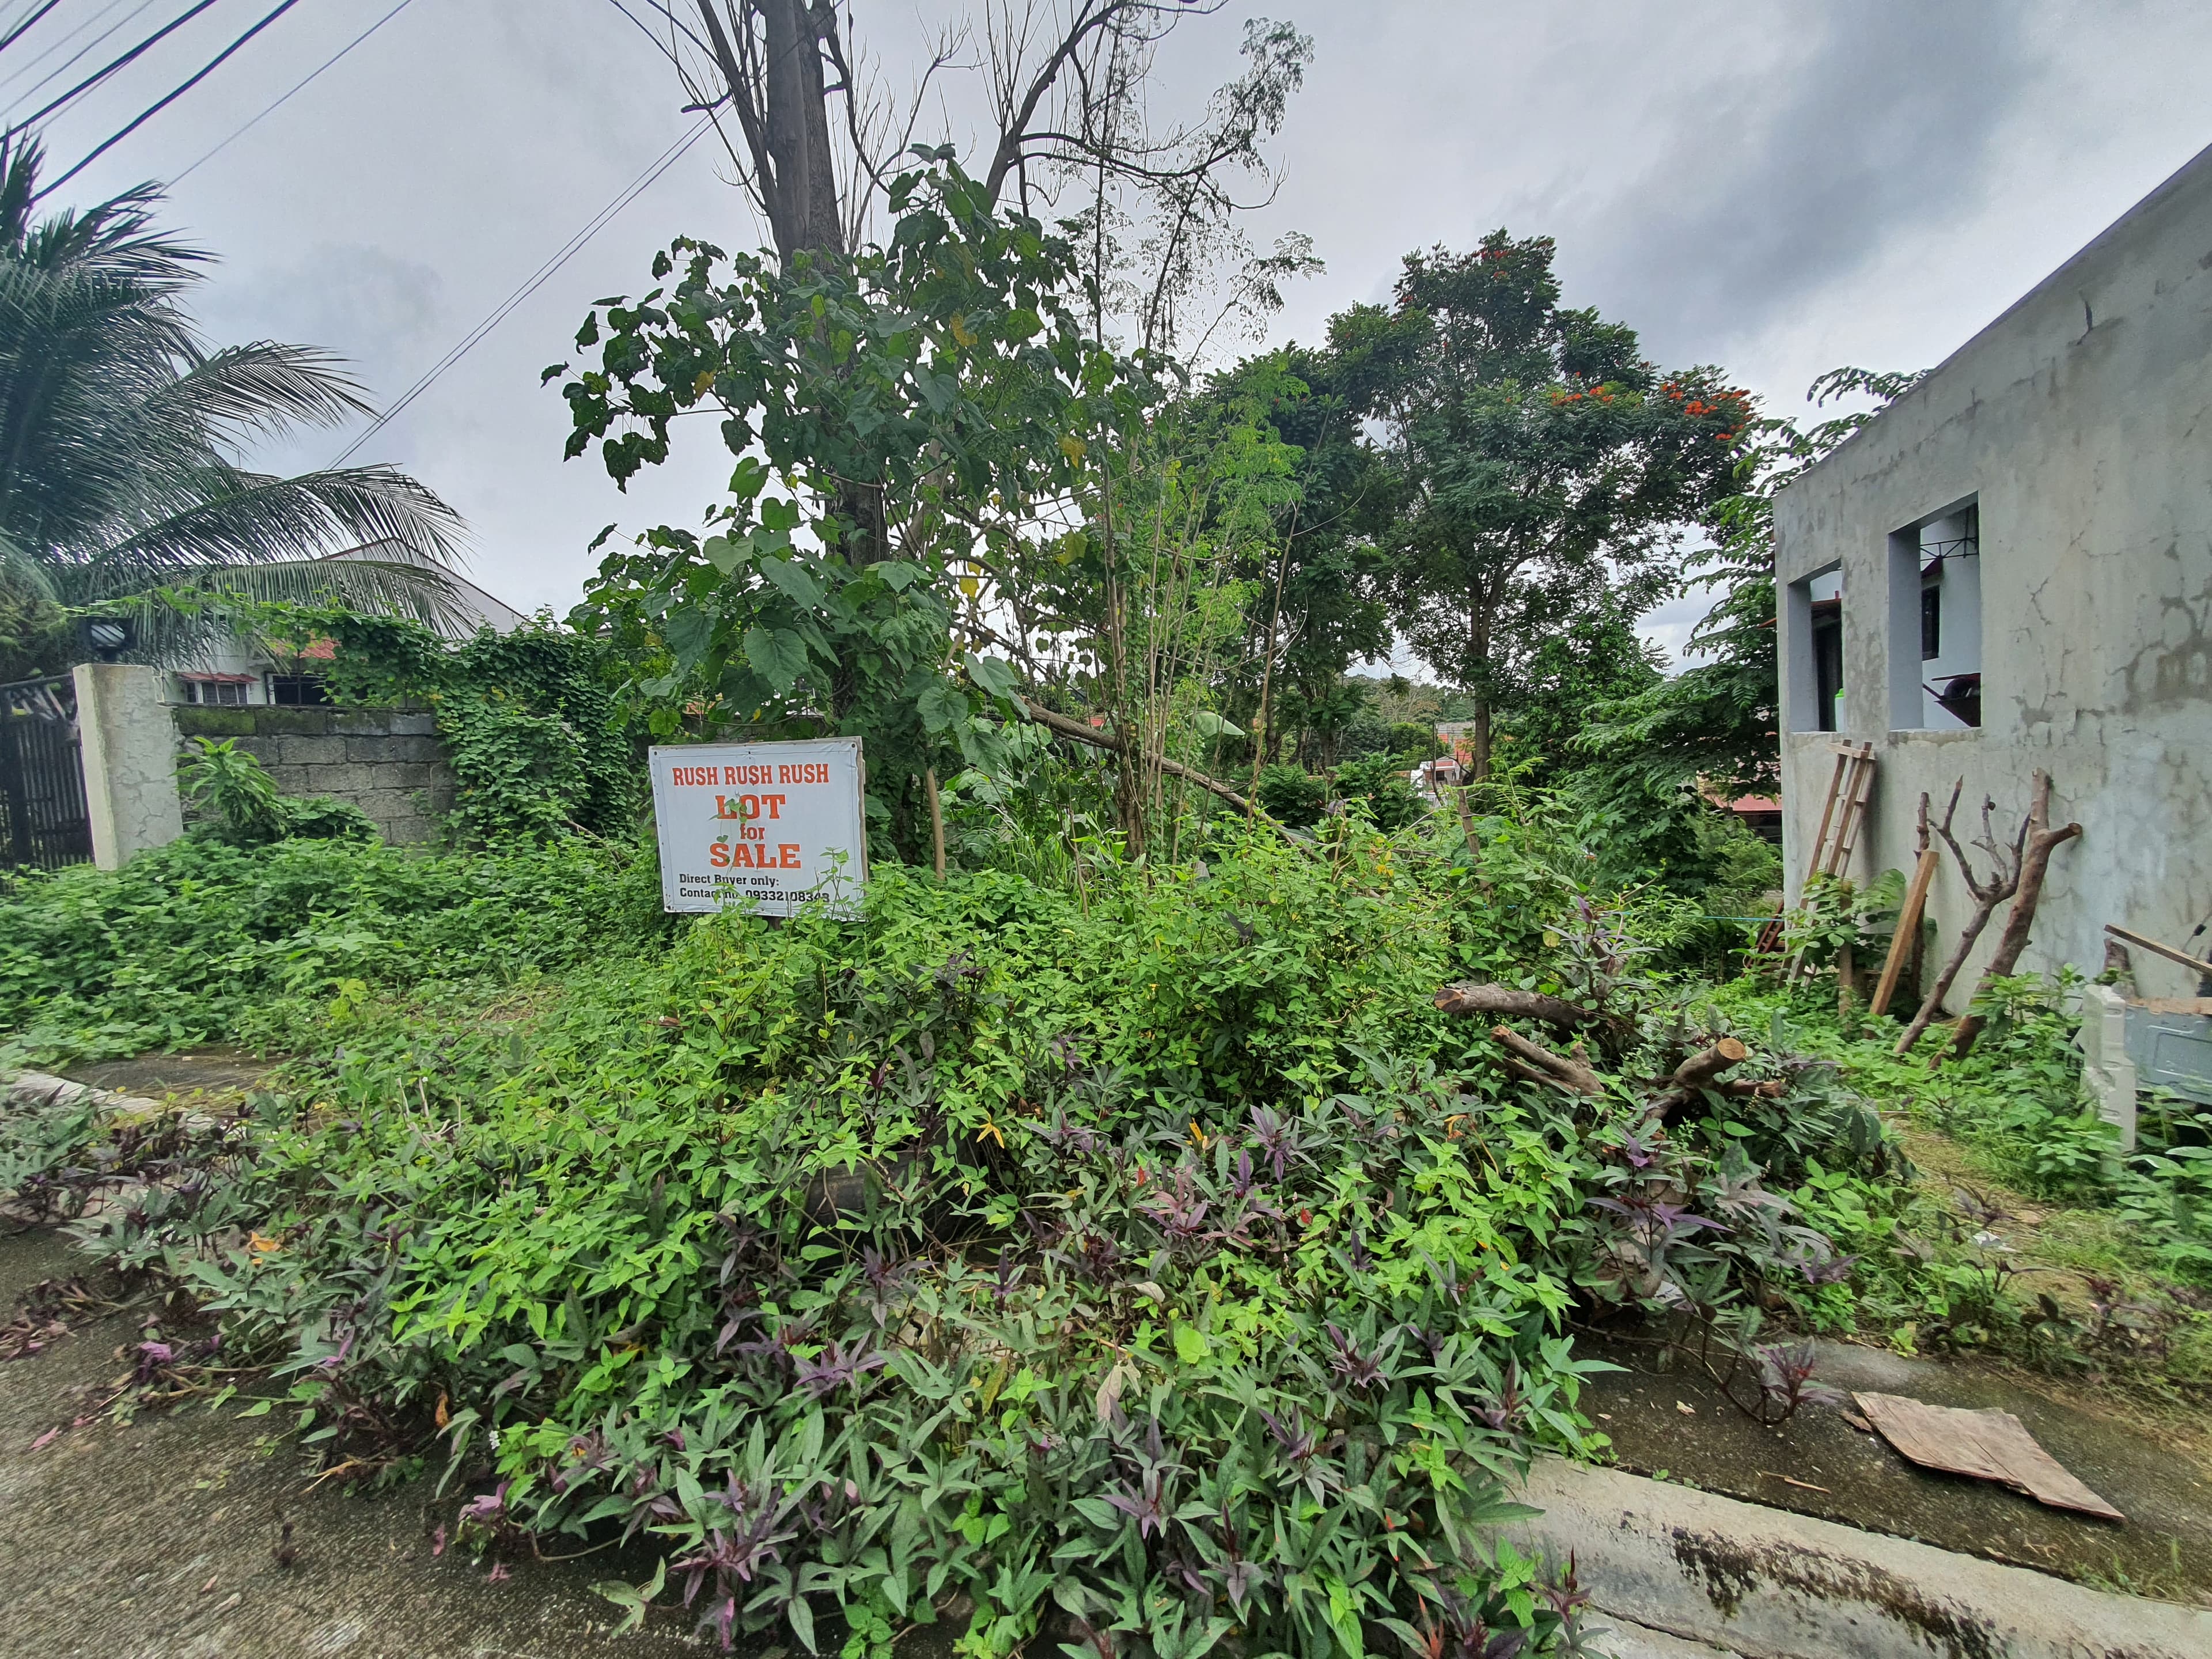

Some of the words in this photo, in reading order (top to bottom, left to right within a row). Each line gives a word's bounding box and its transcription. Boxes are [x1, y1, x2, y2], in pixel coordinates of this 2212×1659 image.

[672, 767, 718, 786] RUSH
[724, 765, 772, 785] RUSH
[778, 764, 829, 783] RUSH
[715, 794, 786, 819] LOT
[740, 823, 765, 840] for
[710, 843, 801, 868] SALE
[679, 873, 711, 884] Direct
[714, 874, 747, 885] Buyer
[751, 876, 779, 888] only:
